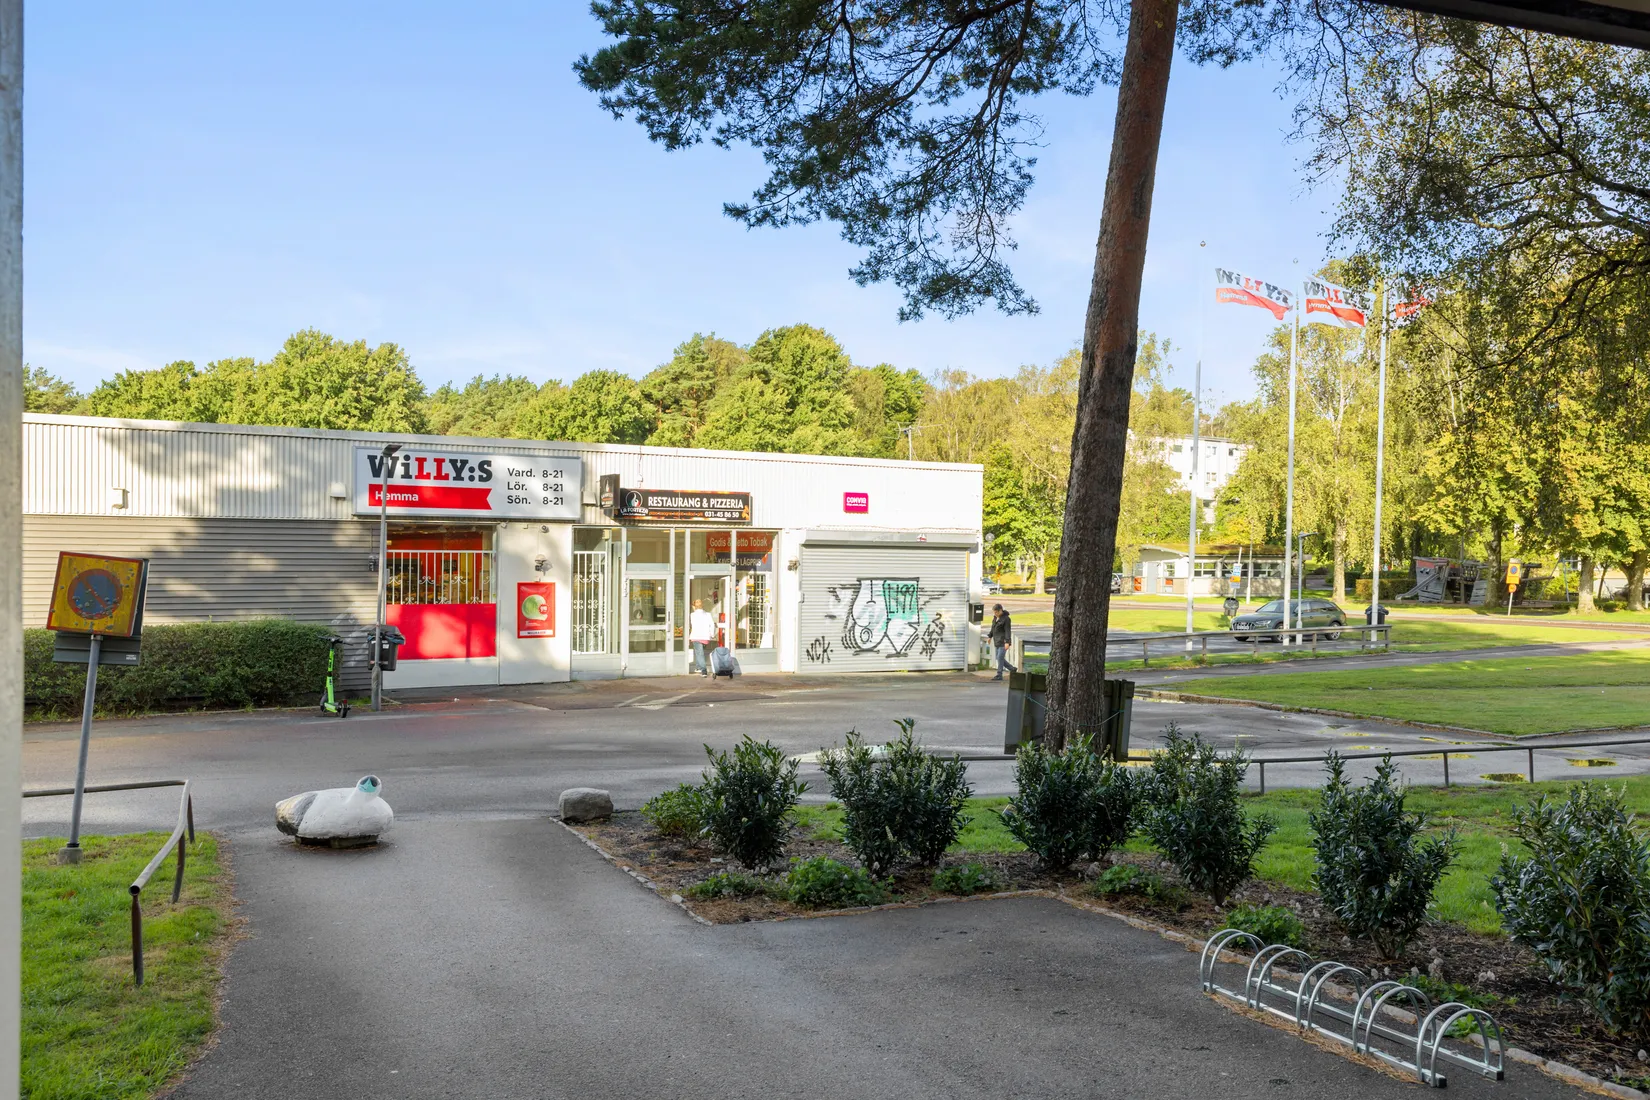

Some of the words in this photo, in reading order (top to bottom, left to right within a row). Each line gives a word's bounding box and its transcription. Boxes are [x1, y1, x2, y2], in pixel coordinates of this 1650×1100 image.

[507, 467, 536, 478] Vard.
[542, 469, 563, 478] 8-21
[507, 481, 528, 491] Lör.
[542, 483, 563, 492] 8-21
[375, 490, 419, 502] Hemma
[507, 494, 531, 505] Sön.
[542, 496, 563, 506] 8-21
[648, 496, 700, 508] RESTAURANG
[702, 498, 709, 508] &
[710, 498, 743, 509] PIZZERIA
[710, 537, 726, 547] Godis
[750, 536, 768, 547] Tobak
